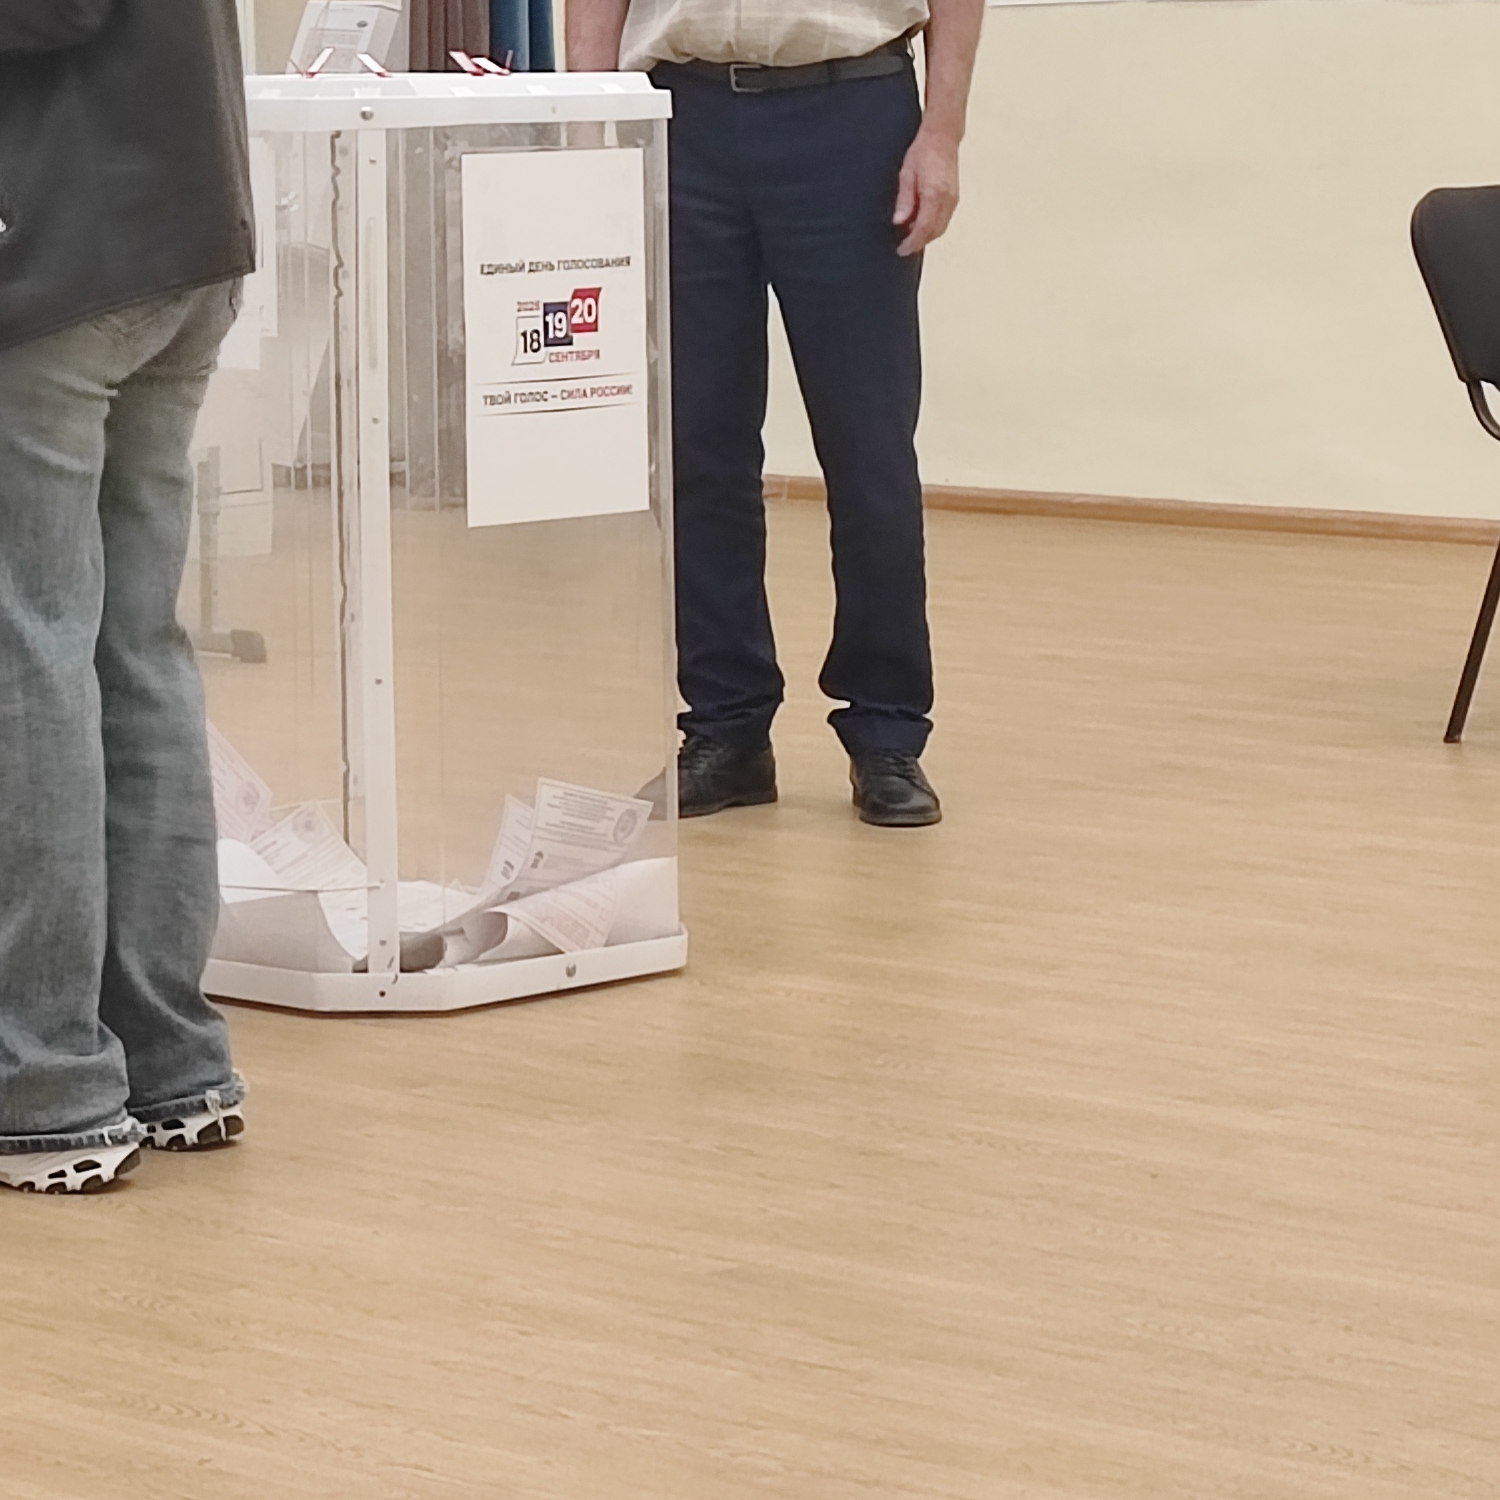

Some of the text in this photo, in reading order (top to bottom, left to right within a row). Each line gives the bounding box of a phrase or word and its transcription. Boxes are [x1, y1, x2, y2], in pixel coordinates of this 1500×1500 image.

[480, 256, 631, 275] ЕДИНЫЙ ДЕНЬ ГОЛОСОВАНИЯ
[520, 298, 596, 354] 18 19 20
[548, 349, 600, 363] СЕНТЯБРЯ
[483, 391, 511, 406] ТВОЙ
[514, 391, 548, 404] ГОЛОС
[560, 388, 588, 401] СИЛА
